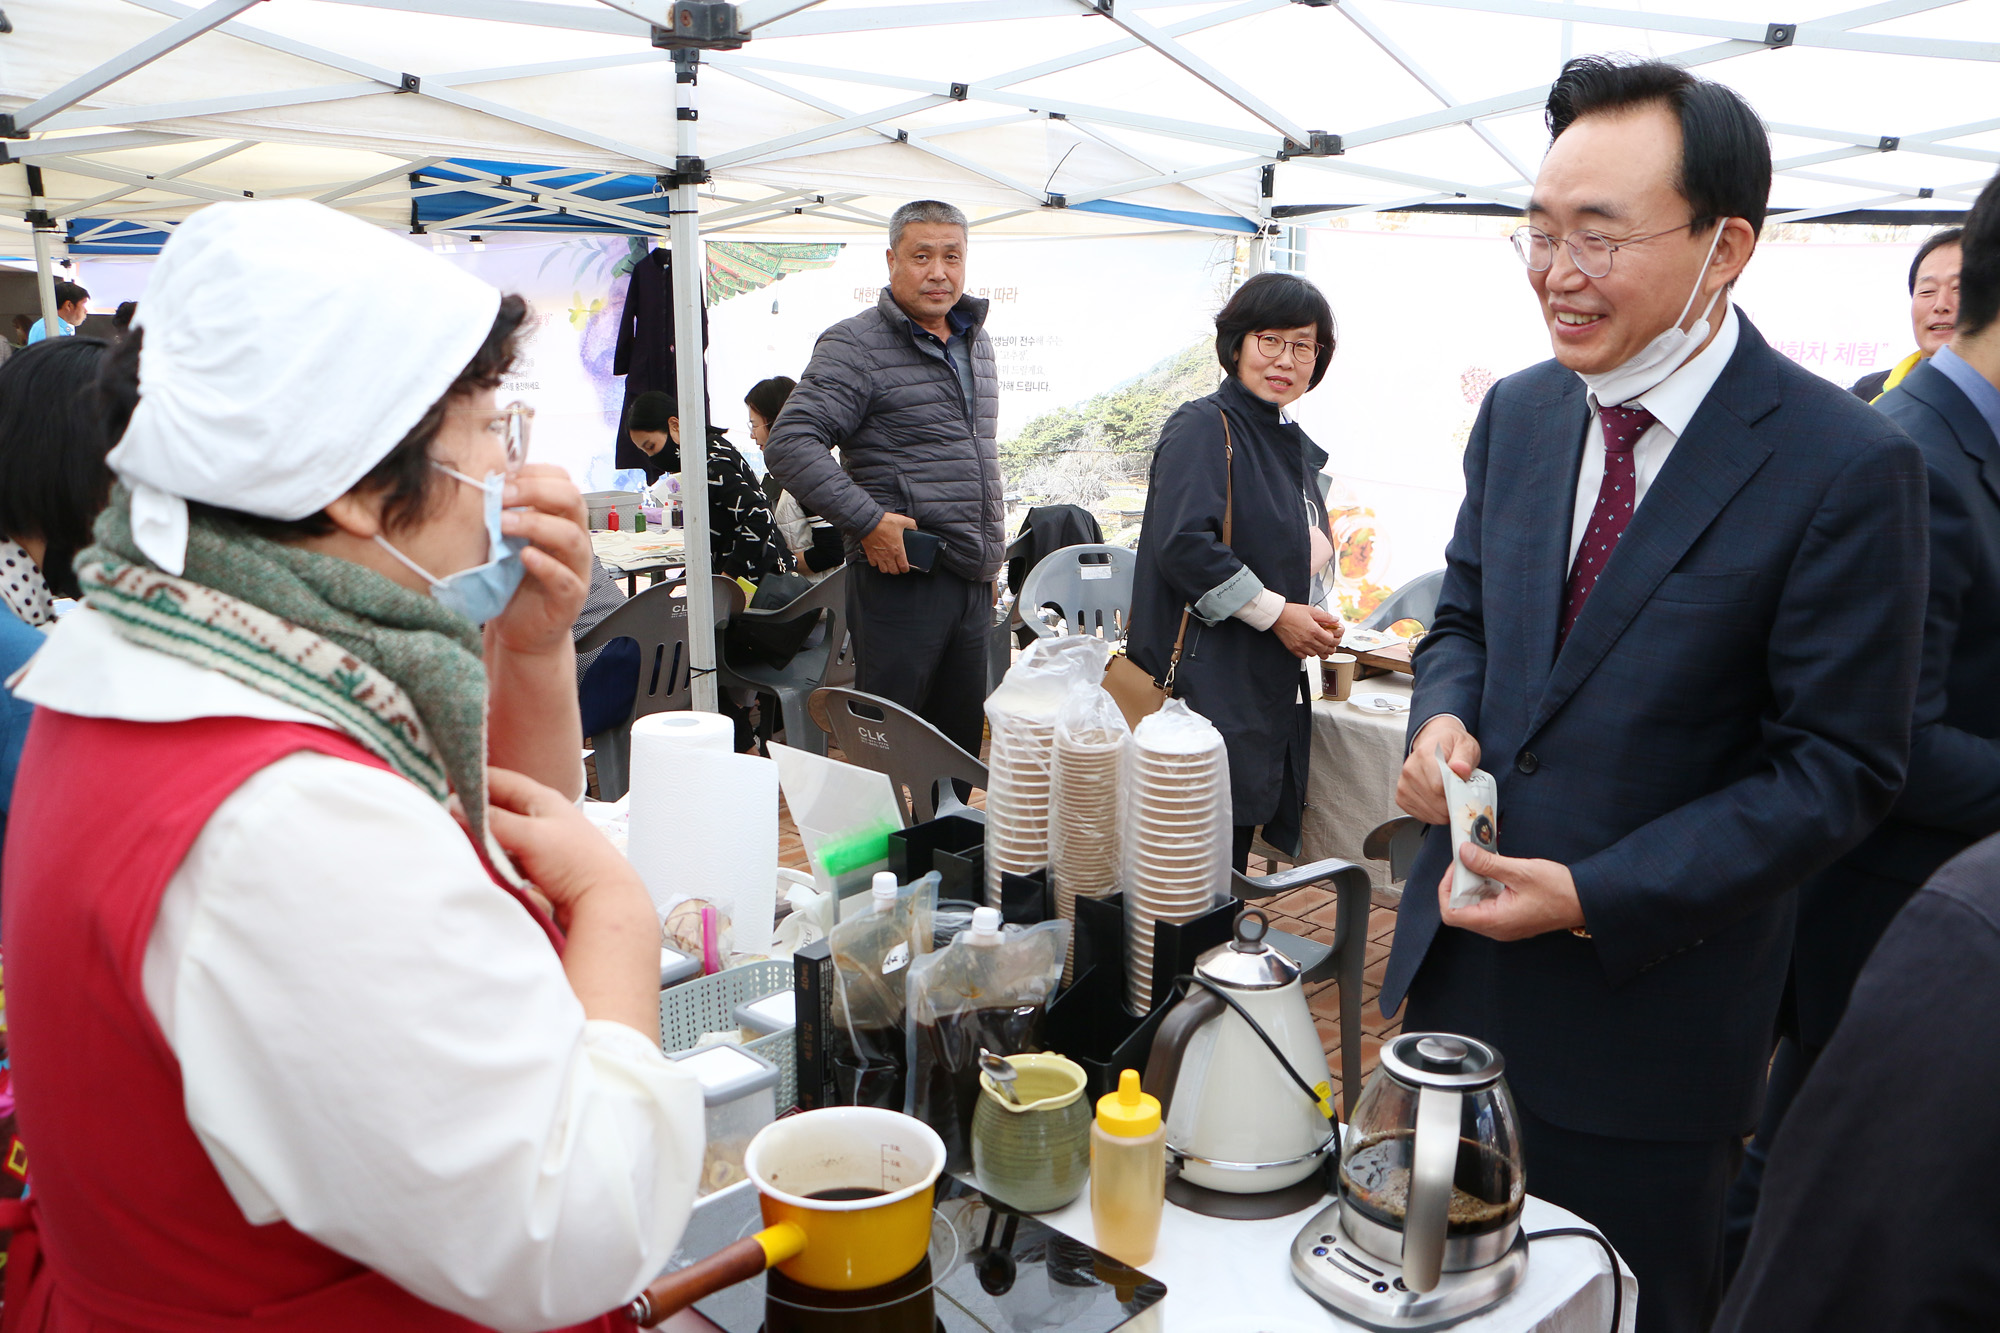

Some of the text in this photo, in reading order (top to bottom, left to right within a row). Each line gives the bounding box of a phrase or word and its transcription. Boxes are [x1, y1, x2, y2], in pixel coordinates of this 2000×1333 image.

[994, 287, 1019, 304] 따라
[672, 604, 688, 613] CL
[858, 726, 888, 743] CLK
